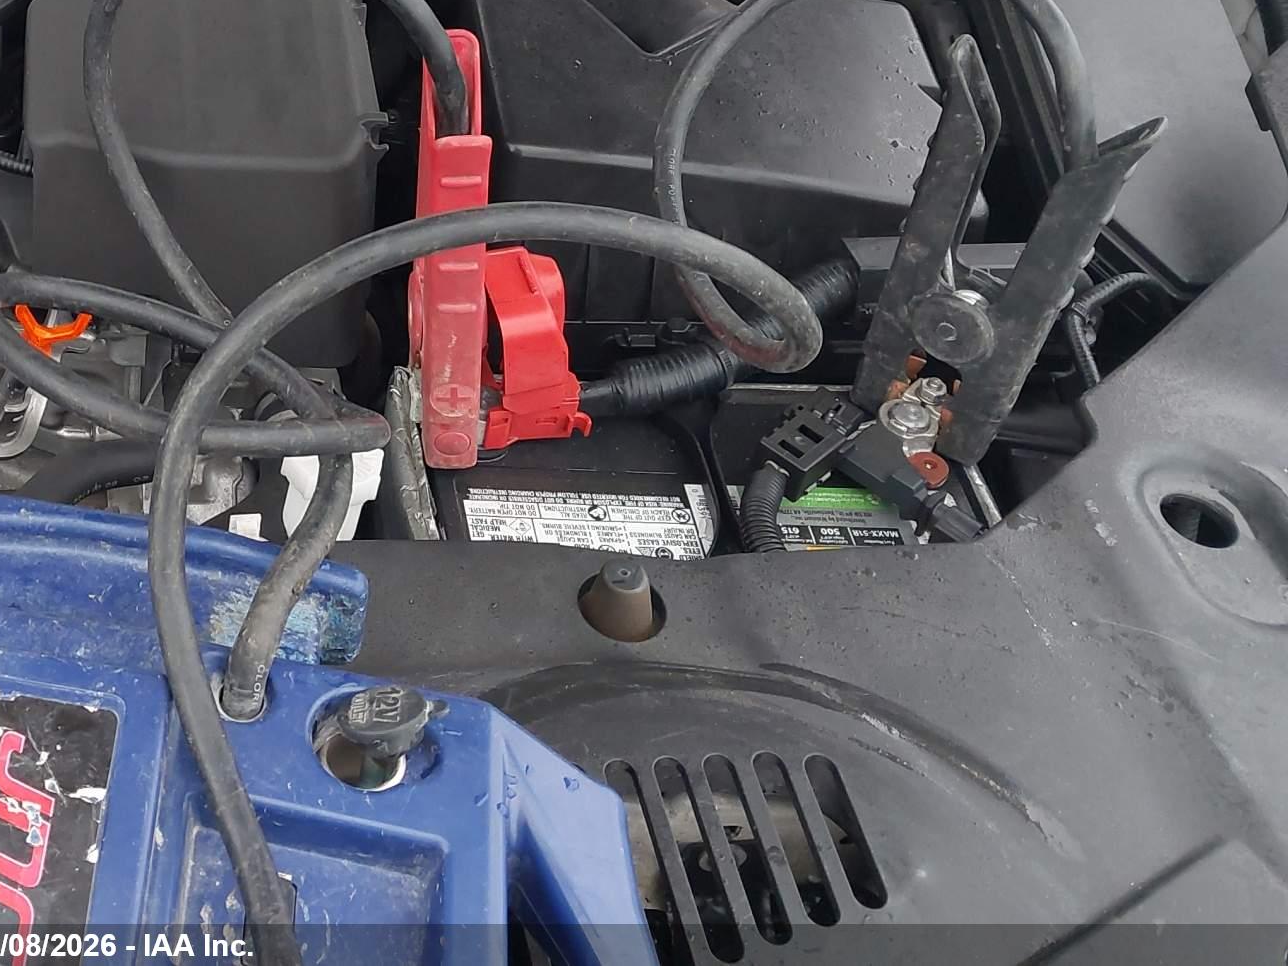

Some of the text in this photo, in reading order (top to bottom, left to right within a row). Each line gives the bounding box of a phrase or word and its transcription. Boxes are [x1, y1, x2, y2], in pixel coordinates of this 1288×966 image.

[470, 524, 500, 532] MEDICAL
[780, 526, 800, 534] 615
[820, 528, 840, 536] 500
[852, 529, 899, 538] MAXX-51R
[372, 686, 405, 723] 12V
